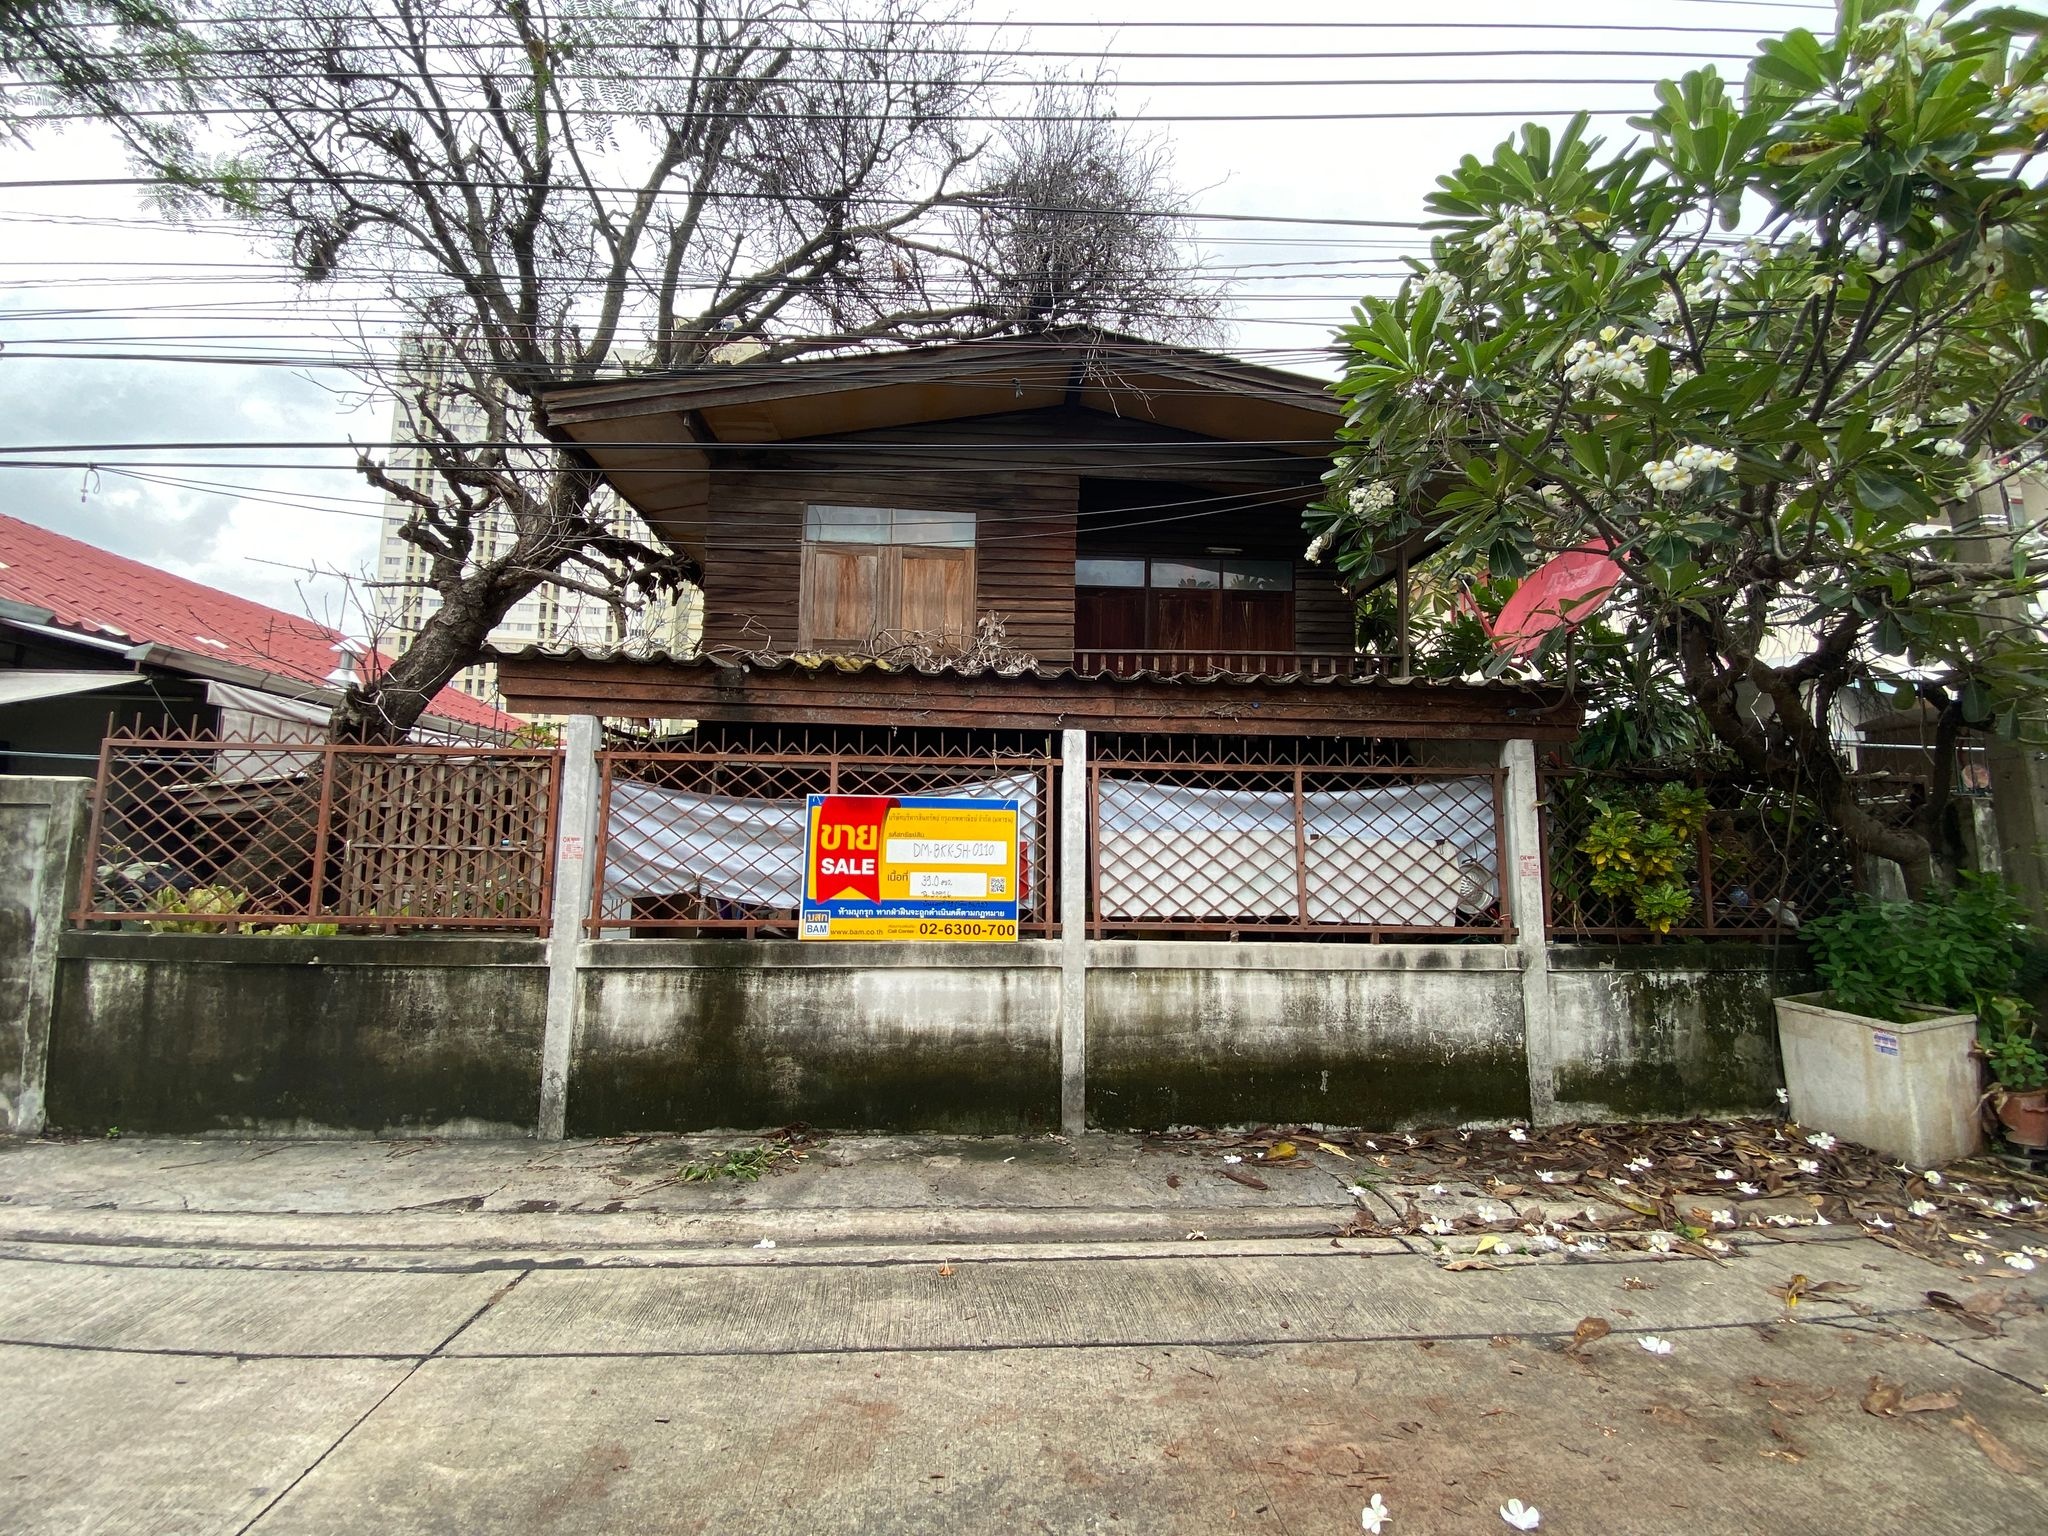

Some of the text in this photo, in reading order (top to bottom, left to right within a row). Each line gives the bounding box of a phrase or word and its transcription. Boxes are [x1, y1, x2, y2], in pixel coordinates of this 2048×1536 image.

[821, 824, 877, 850] ขาย
[821, 858, 875, 875] SALE
[887, 870, 909, 882] เนื้อที่
[806, 912, 828, 922] บสก
[838, 907, 874, 918] ห้ามบุกรุก
[806, 924, 827, 933] BAM
[919, 922, 1015, 937] 02-6300-700
